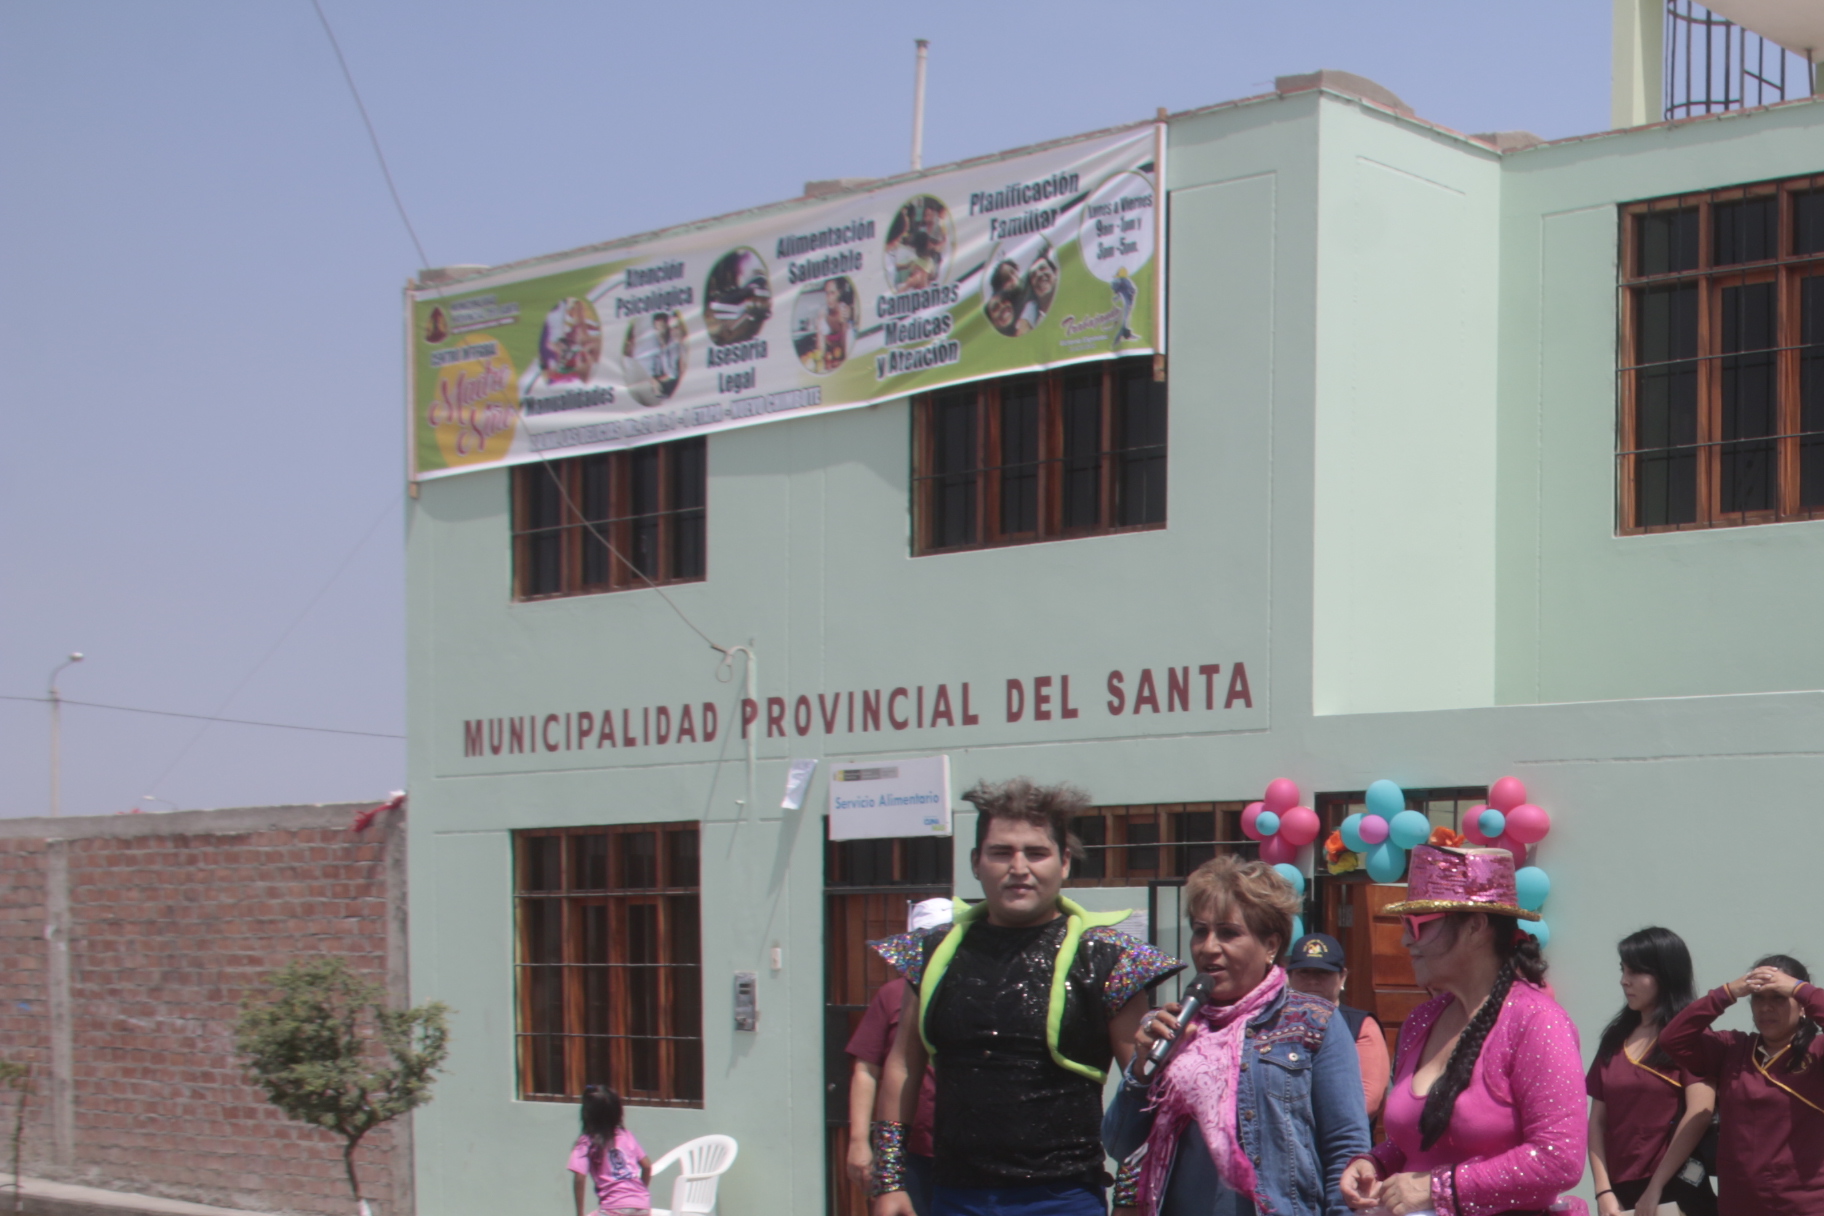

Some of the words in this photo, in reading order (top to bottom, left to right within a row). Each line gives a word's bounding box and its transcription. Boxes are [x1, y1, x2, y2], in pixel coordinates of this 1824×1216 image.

[969, 171, 1079, 216] Planificación
[776, 217, 875, 260] Alimentación
[990, 209, 1059, 241] Familiar
[788, 249, 863, 285] Saludable
[876, 283, 959, 319] Campañas
[718, 366, 755, 394] Legal
[877, 356, 886, 380] y
[526, 386, 615, 417] Manualidades
[464, 702, 718, 758] MUNICIPALIDAD
[741, 682, 979, 739] PROVINCIAL
[1006, 674, 1079, 723] DEL
[1106, 662, 1253, 716] SANTA
[835, 794, 876, 809] Servicio
[878, 790, 940, 807] Alimentario
